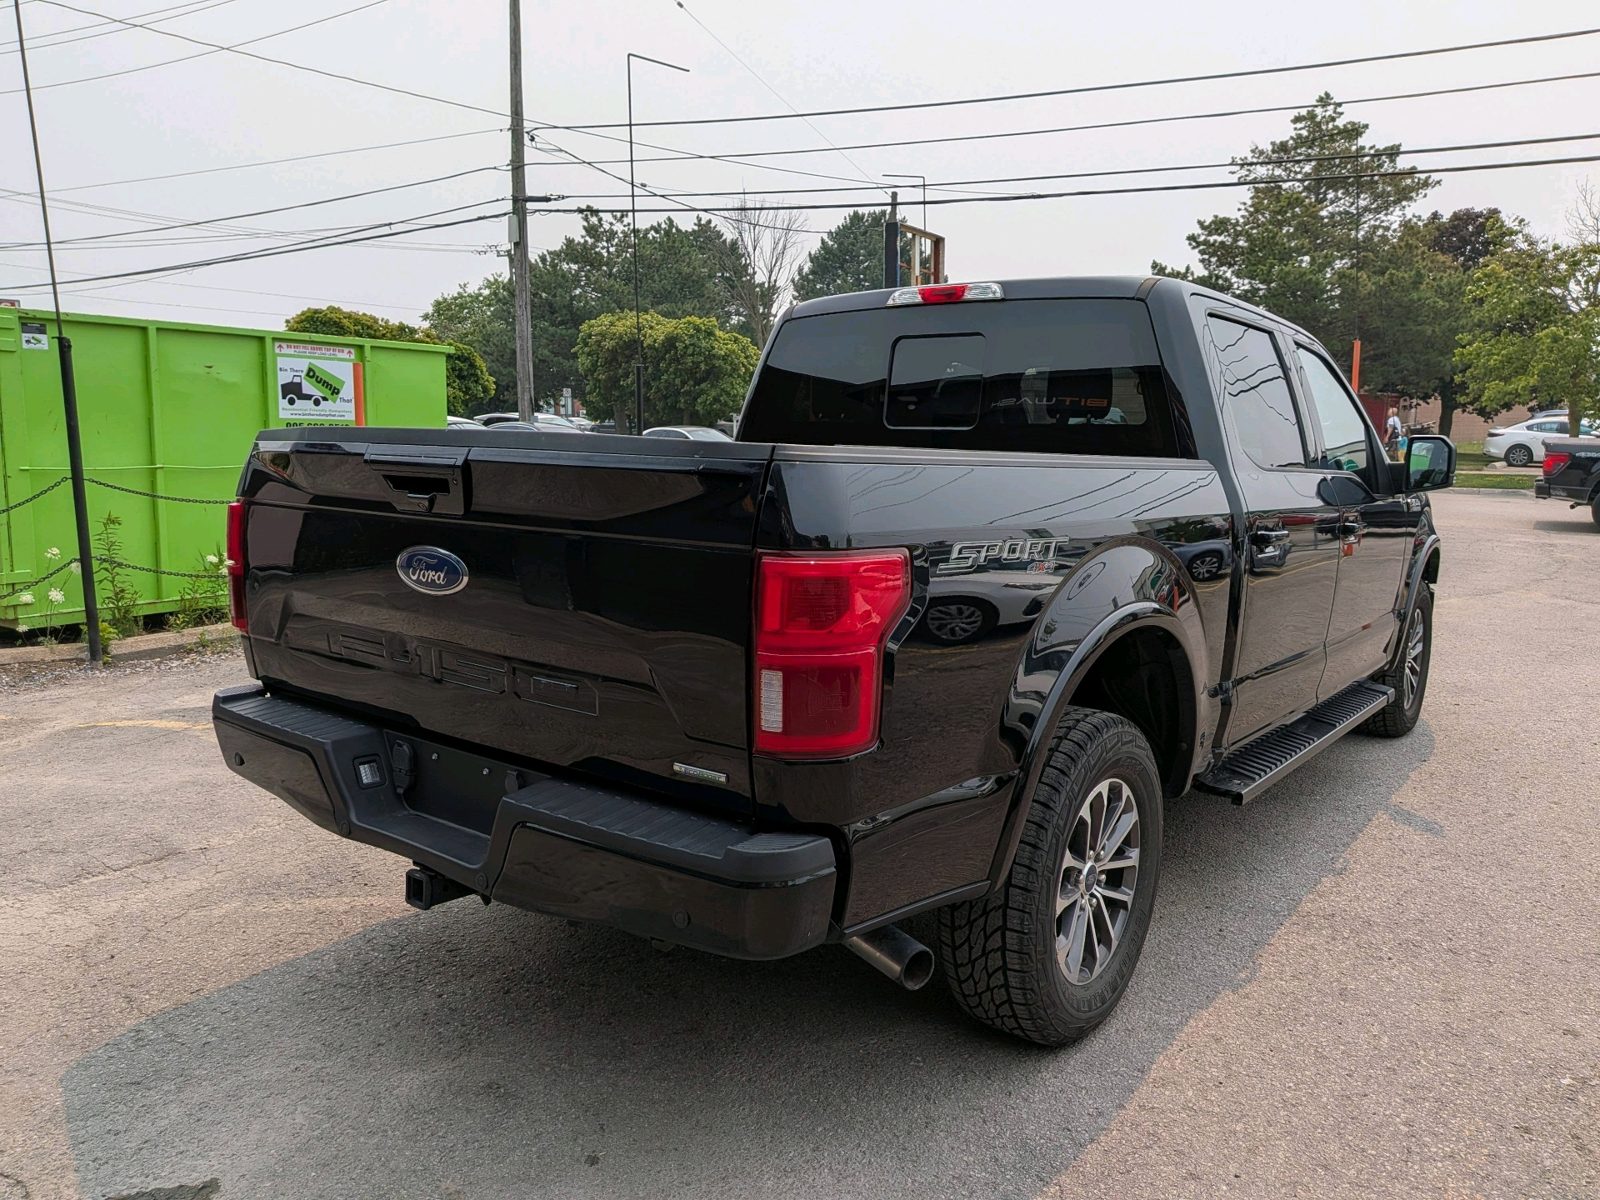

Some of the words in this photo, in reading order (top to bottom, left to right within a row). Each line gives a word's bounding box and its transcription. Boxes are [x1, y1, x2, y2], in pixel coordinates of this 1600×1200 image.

[305, 367, 340, 396] Dump
[409, 555, 448, 585] Ford
[936, 536, 1070, 574] SPORT
